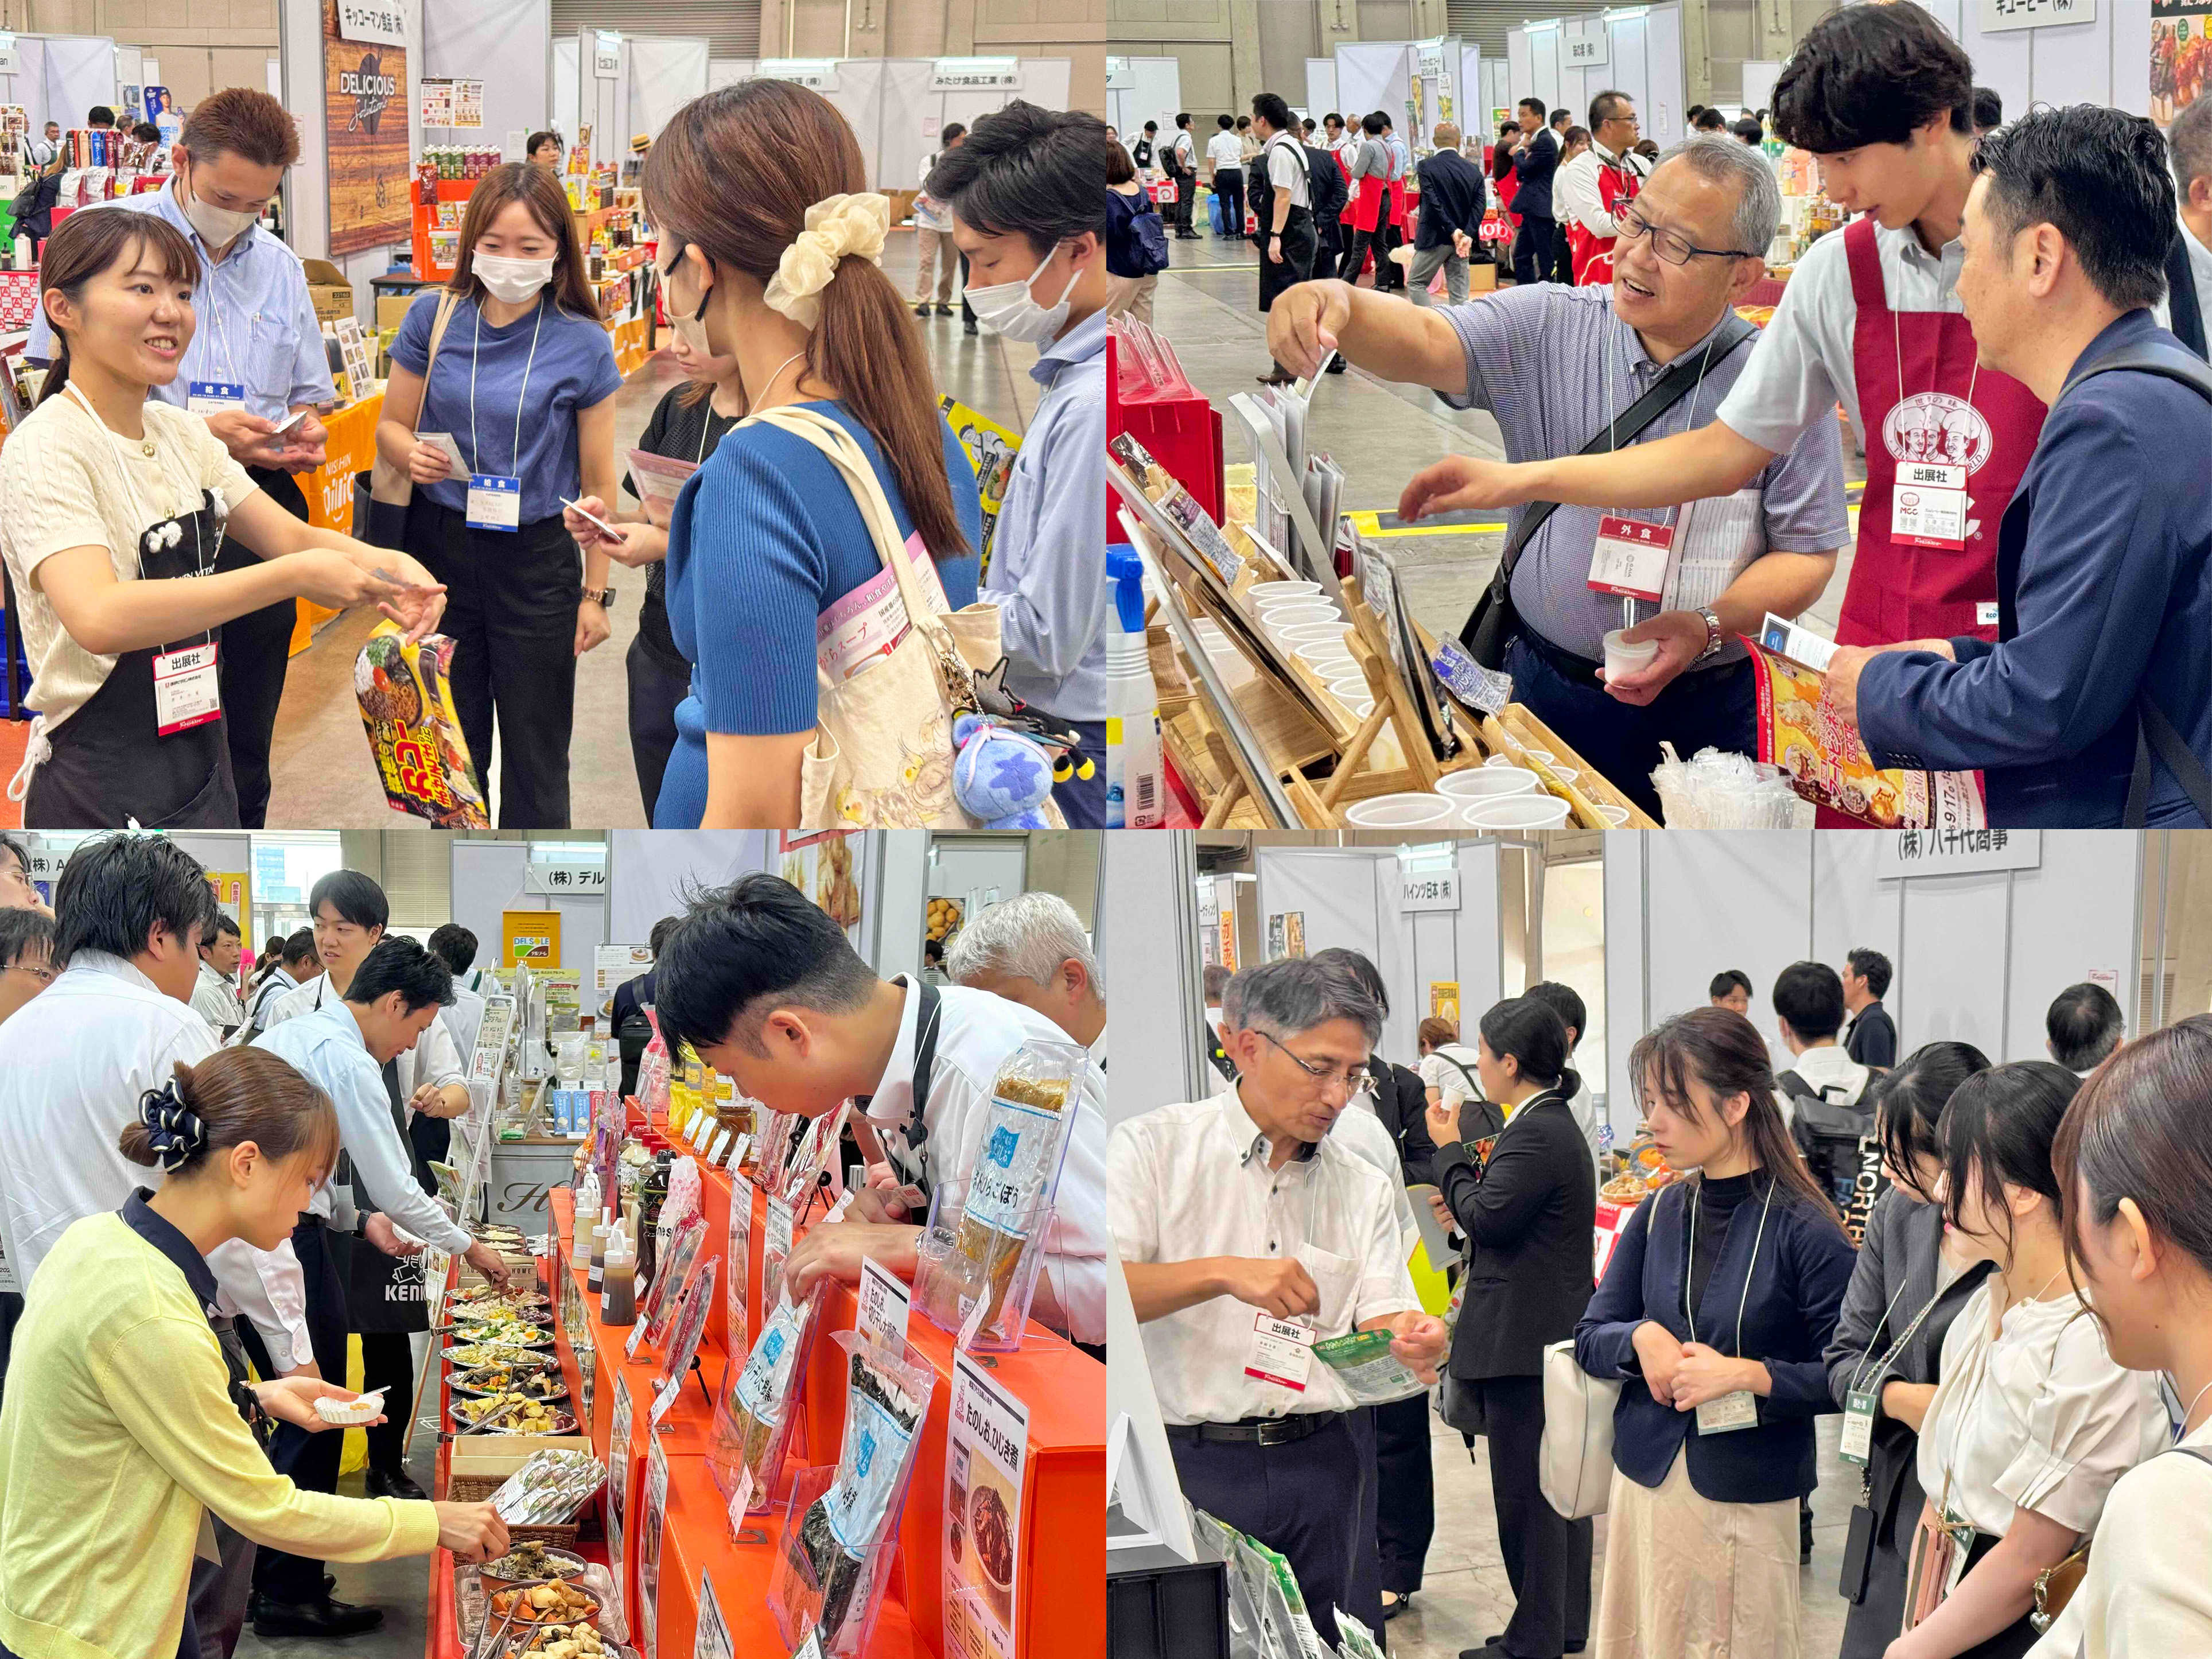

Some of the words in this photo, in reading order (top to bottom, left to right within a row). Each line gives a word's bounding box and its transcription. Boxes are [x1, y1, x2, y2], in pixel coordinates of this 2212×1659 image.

[345, 5, 393, 33] キッコーマン食品
[340, 72, 395, 96] DELICIOUS
[934, 75, 998, 86] みたけ食品工業
[204, 385, 230, 395] 給食
[1914, 469, 1947, 483] 出展社
[1900, 507, 1919, 515] MCC
[1620, 524, 1651, 539] 外食
[172, 652, 201, 670] 出展社
[1898, 830, 1922, 861] (株)
[549, 871, 573, 886] (株)
[578, 871, 605, 885] デル
[1404, 880, 1439, 900] ハインツ日本
[1440, 879, 1452, 900] (株)
[1272, 1323, 1301, 1339] 出展社
[992, 1427, 1020, 1472] ひじき煮
